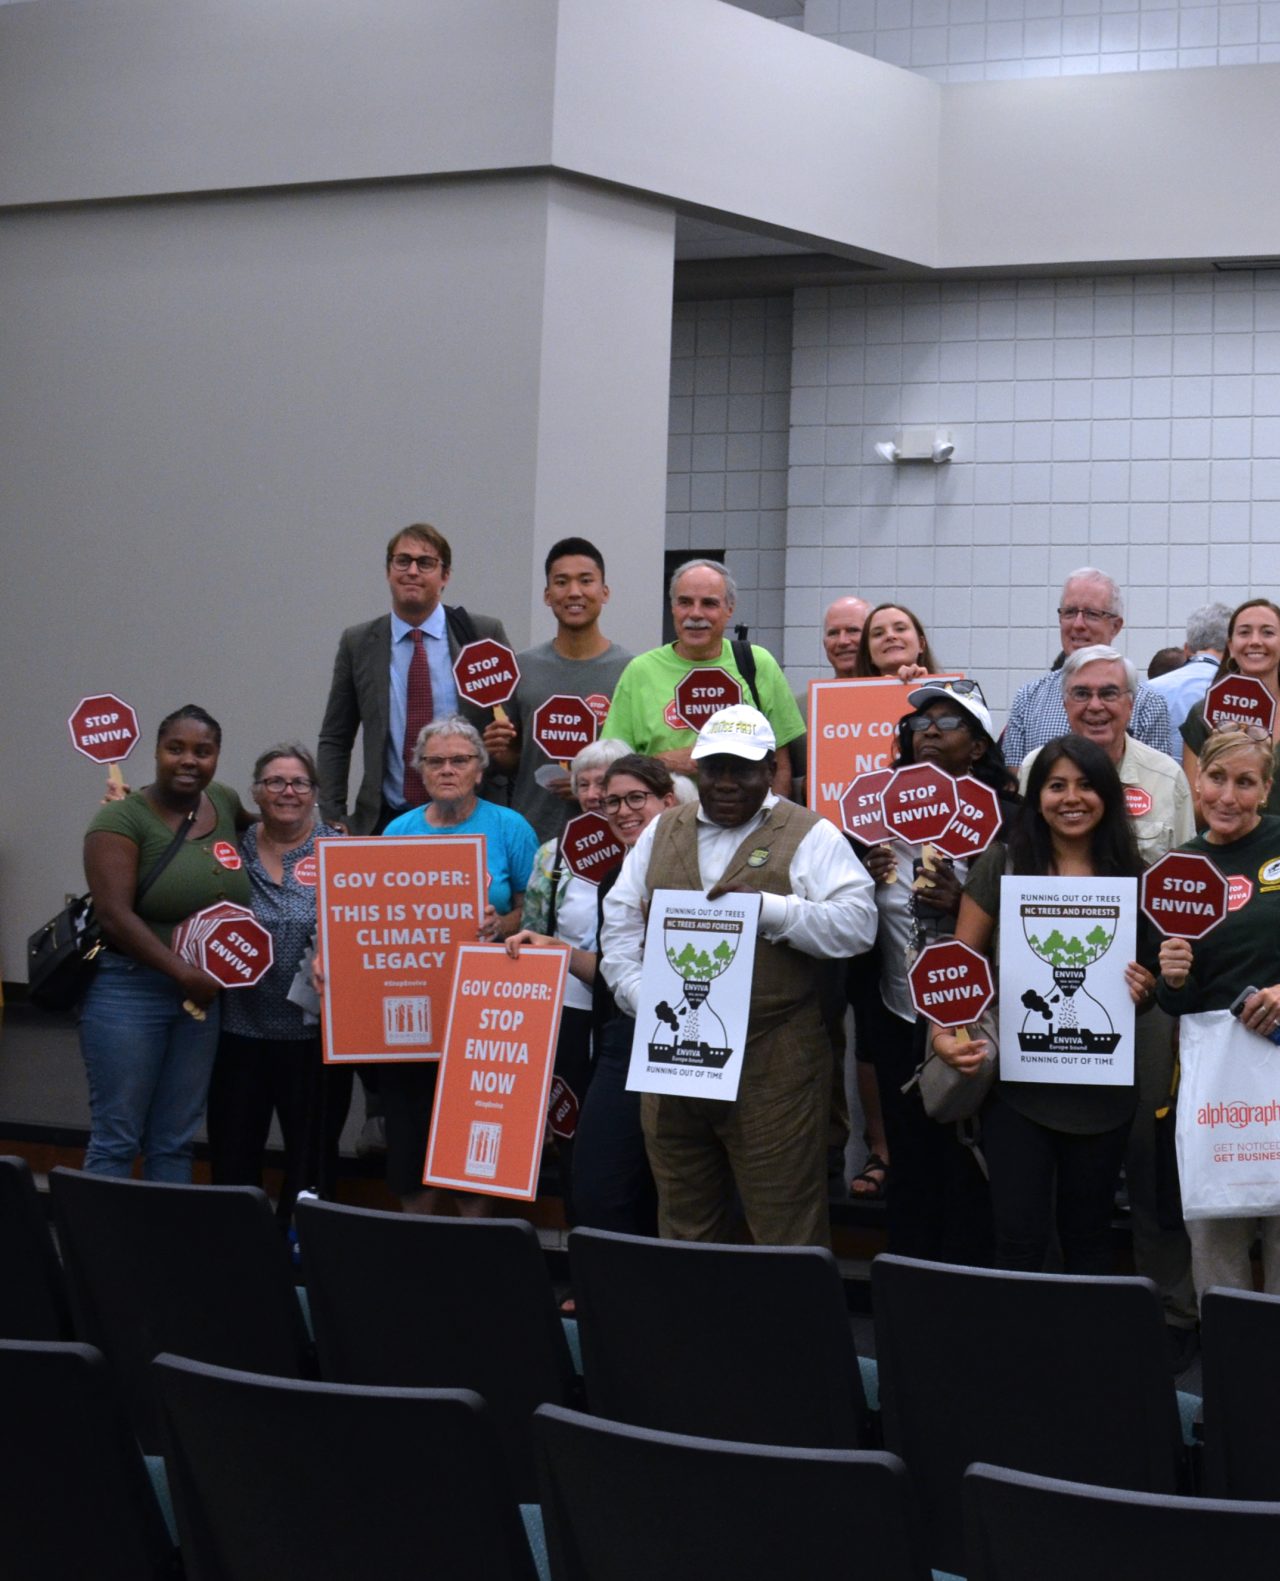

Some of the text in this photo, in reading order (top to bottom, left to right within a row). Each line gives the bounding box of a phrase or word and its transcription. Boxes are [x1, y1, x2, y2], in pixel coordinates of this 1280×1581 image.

[468, 657, 499, 675] STOP
[465, 670, 512, 693] ENVIVA
[692, 687, 725, 698] STOP
[1223, 694, 1258, 709] STOP
[85, 713, 119, 728] STOP
[549, 714, 581, 725] STOP
[81, 728, 132, 746] ENVIVA
[541, 729, 588, 742] ENVIVA
[823, 723, 862, 738] GOV
[855, 753, 886, 773] NC
[899, 785, 937, 803] STOP
[852, 811, 881, 827] ENV
[893, 802, 950, 824] ENVIVA
[575, 830, 604, 851] STOP
[576, 843, 620, 871] ENVIVA
[333, 871, 470, 888] GOV COOPER:
[1163, 877, 1206, 893] STOP
[1021, 894, 1059, 902] RUNNING
[1062, 894, 1079, 902] OUT
[1096, 895, 1120, 903] TREES
[1152, 898, 1215, 916] ENVIVA
[331, 903, 473, 921] THIS IS YOUR
[665, 907, 696, 916] RUNNING
[698, 909, 713, 917] OUT
[725, 910, 745, 918] TREES
[1025, 907, 1116, 916] NC TREES AND FORESTS
[667, 920, 740, 931] NC TREES AND FORESTS
[227, 931, 259, 958] STOP
[356, 928, 450, 945] CLIMATE
[209, 939, 252, 979] ENVIVA
[363, 952, 446, 969] LEGACY
[928, 965, 968, 983] STOP
[1055, 970, 1084, 978] ENVIVA
[461, 980, 552, 1000] GOV COOPER:
[684, 982, 709, 991] ENVIVA
[922, 984, 984, 1006] ENVIVA
[479, 1009, 524, 1031] STOP
[1054, 1036, 1083, 1044] ENVIVA
[465, 1039, 529, 1064] ENVIVA
[1021, 1056, 1059, 1064] RUNNING
[647, 1066, 678, 1075] RUNNING
[679, 1068, 694, 1077] OUT
[706, 1071, 723, 1080] TIME
[470, 1071, 515, 1094] NOW
[1214, 1143, 1233, 1152] GET
[1214, 1154, 1234, 1163] GET
